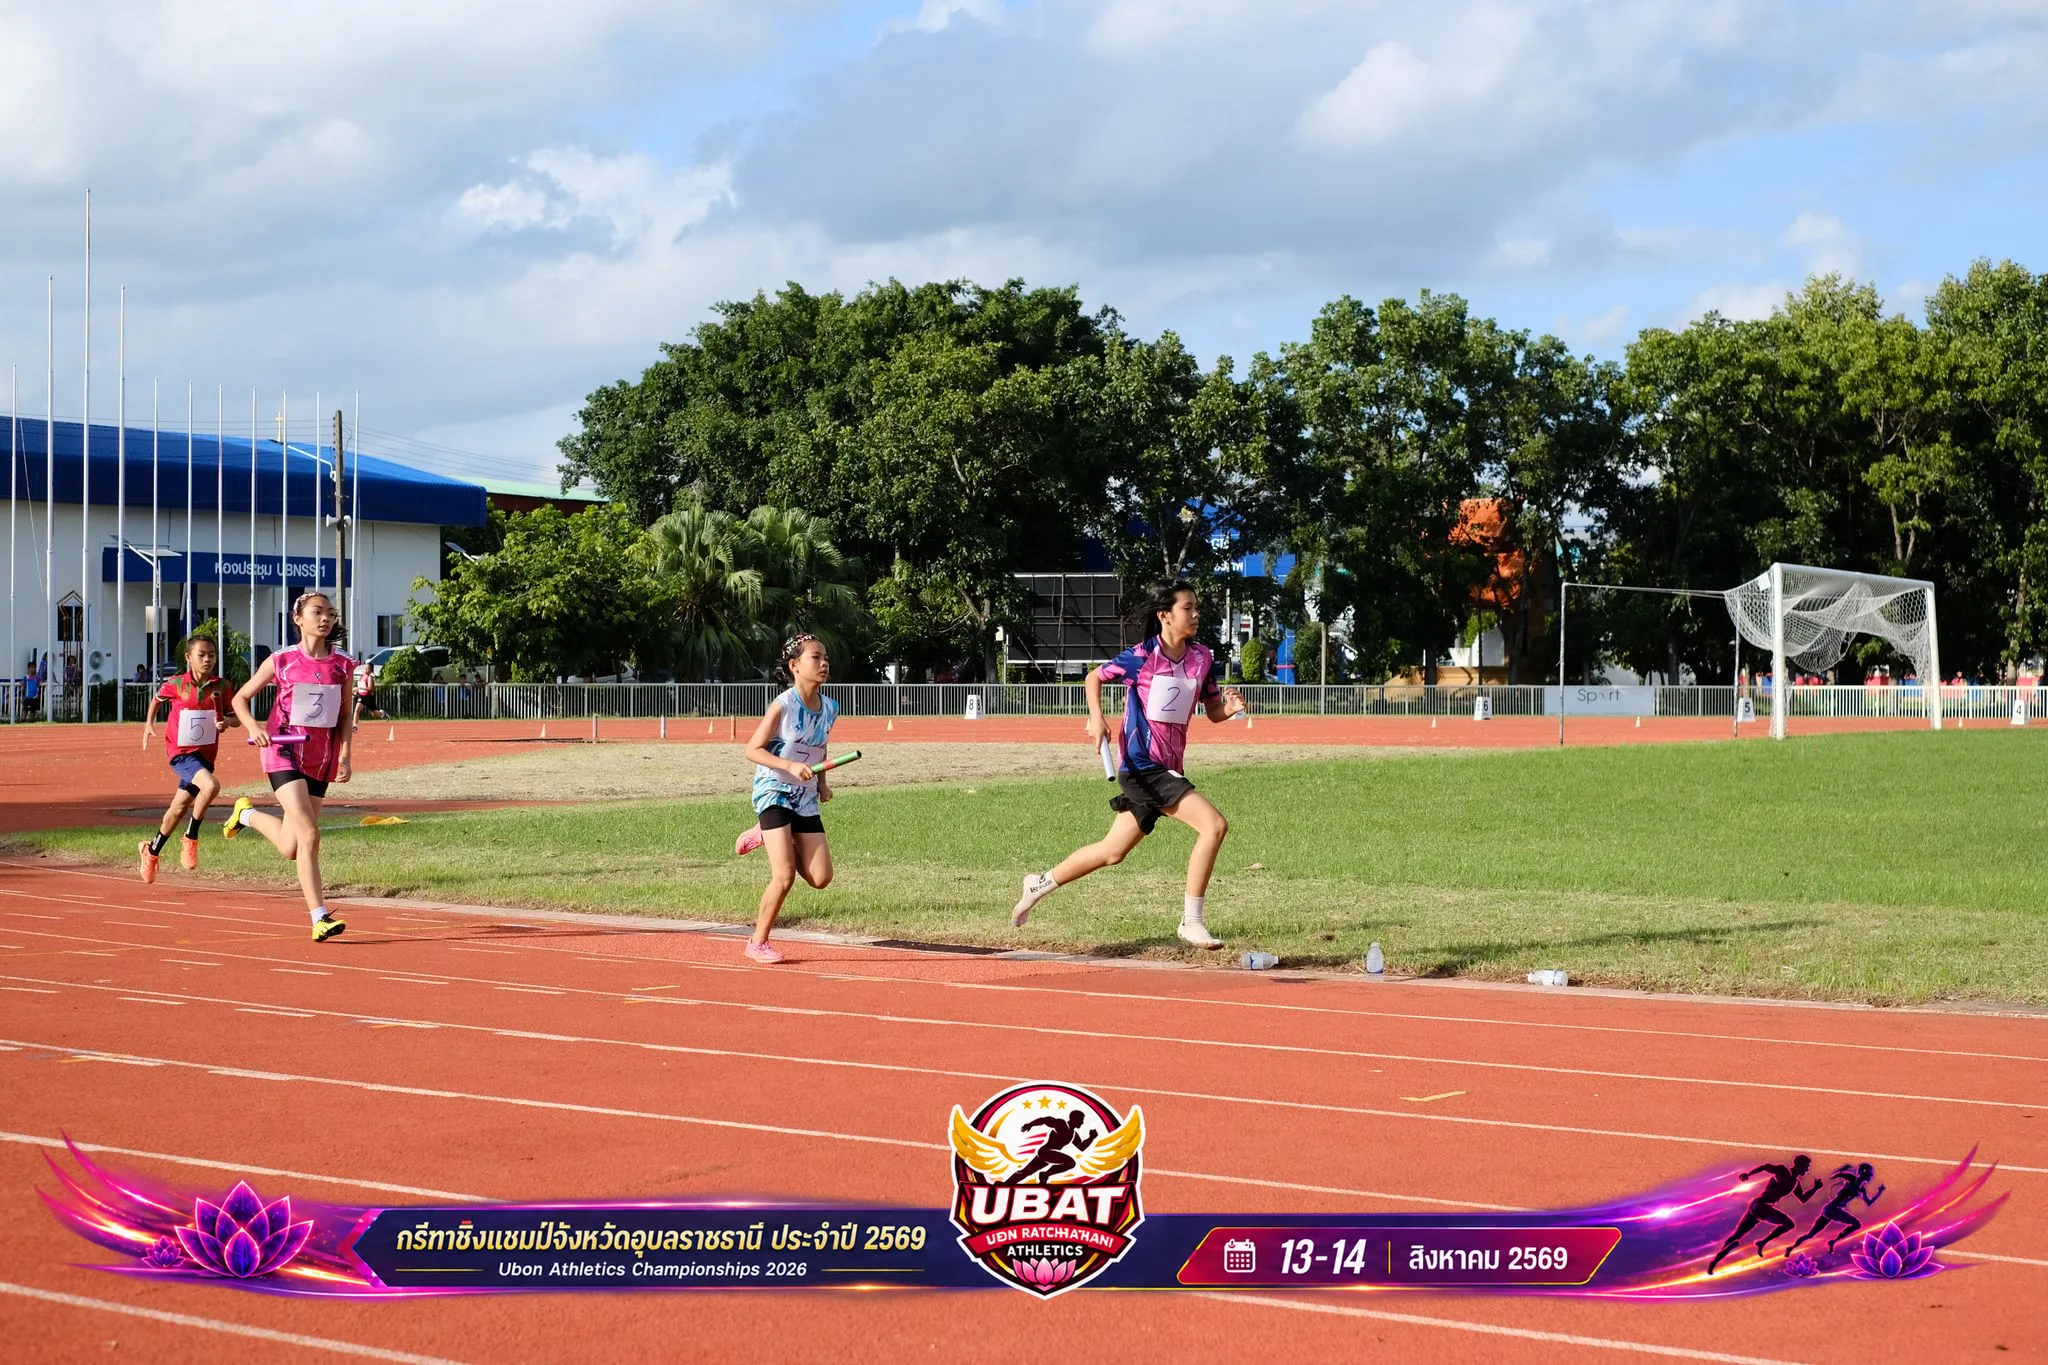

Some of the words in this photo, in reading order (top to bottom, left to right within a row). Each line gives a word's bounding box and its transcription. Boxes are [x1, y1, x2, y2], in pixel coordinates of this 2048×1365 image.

[968, 698, 974, 710] 8
[1161, 686, 1181, 712] 2
[306, 692, 324, 719] 3
[1483, 700, 1489, 712] 6
[1744, 701, 1751, 713] 5
[2016, 704, 2022, 716] 4
[190, 717, 207, 741] 5
